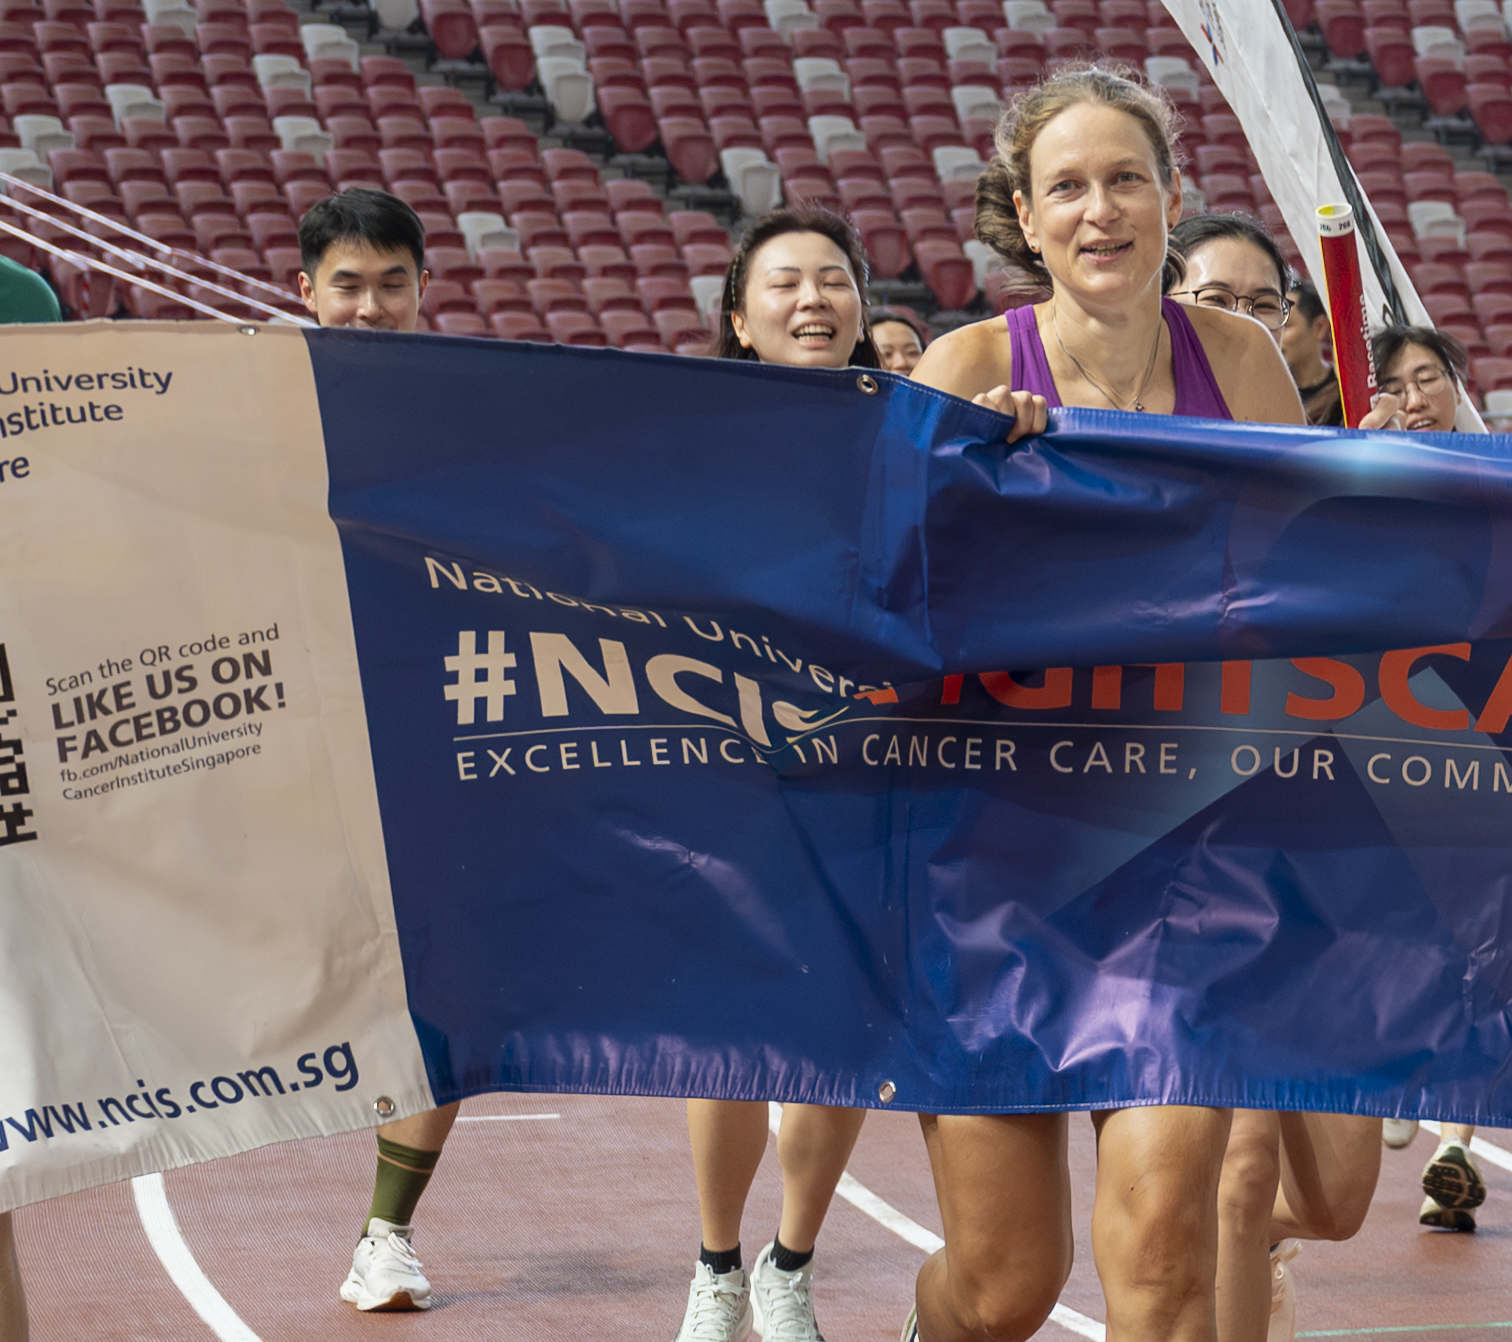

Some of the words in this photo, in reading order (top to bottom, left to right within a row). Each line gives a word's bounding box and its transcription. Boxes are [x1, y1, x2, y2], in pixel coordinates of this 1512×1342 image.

[424, 557, 668, 628] National
[45, 670, 93, 696] Scan
[98, 658, 133, 679] the
[139, 645, 172, 666] QR
[178, 633, 231, 658] code
[238, 622, 280, 646] and
[51, 680, 136, 731] LIKE
[145, 664, 198, 701] US
[211, 649, 273, 685] ON
[56, 681, 287, 764] FACEBOOK!
[59, 722, 264, 783] fb.com/NationalUniversity
[792, 734, 838, 766] IN
[862, 734, 1018, 772] CANCER
[1049, 741, 1199, 780] CARE,
[1231, 744, 1336, 781] OUR
[62, 743, 262, 801] CancerInstituteSingapore
